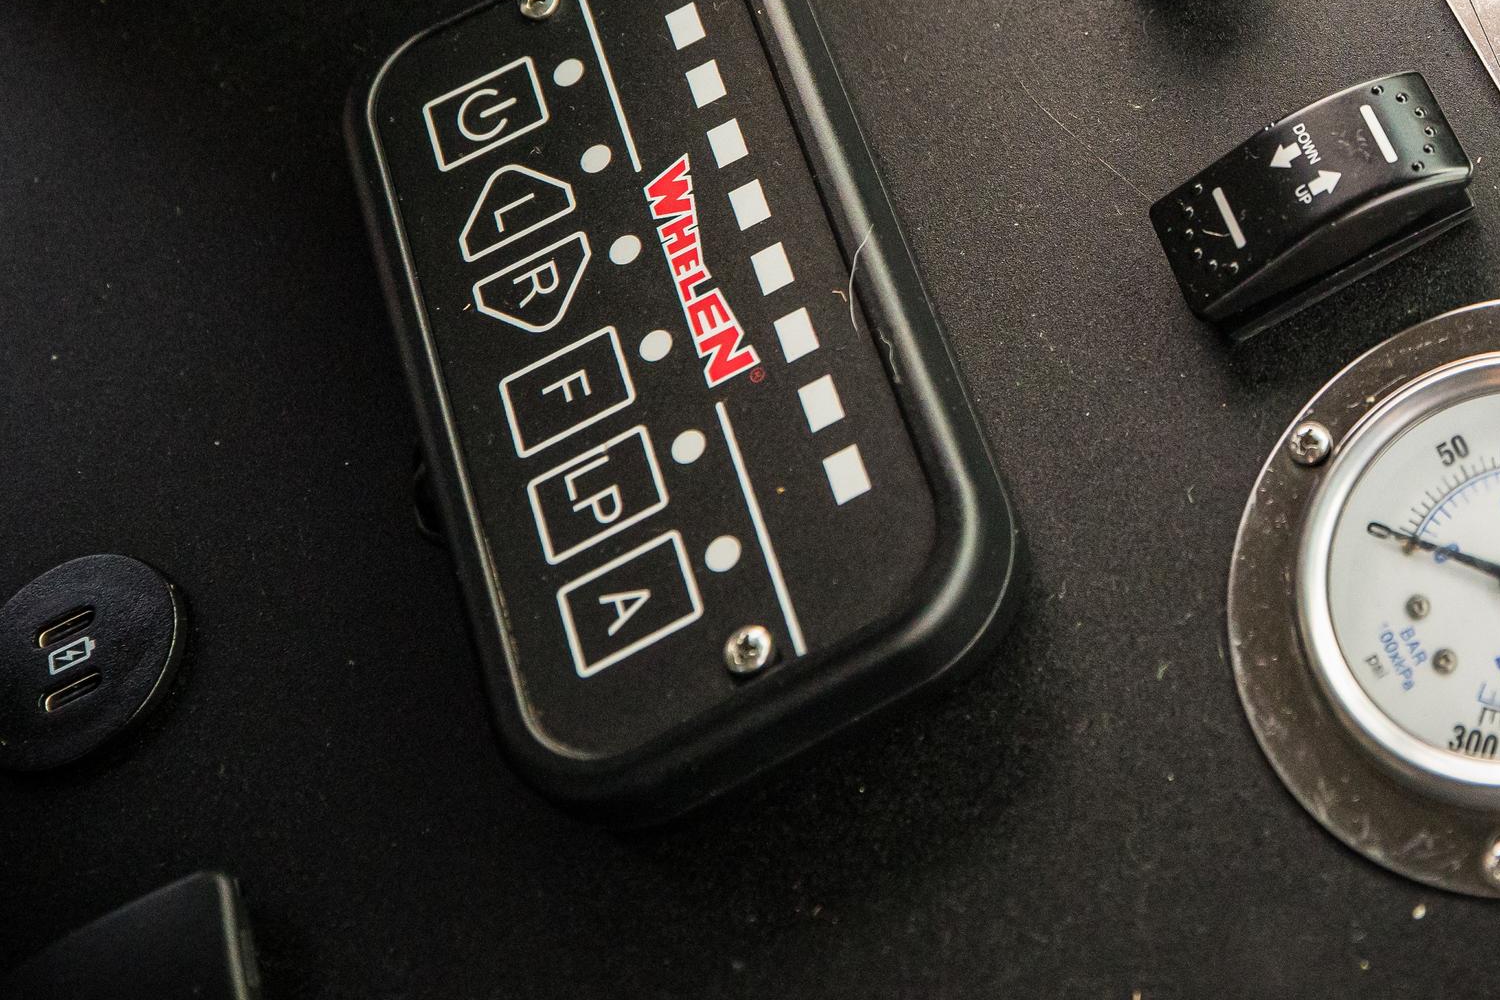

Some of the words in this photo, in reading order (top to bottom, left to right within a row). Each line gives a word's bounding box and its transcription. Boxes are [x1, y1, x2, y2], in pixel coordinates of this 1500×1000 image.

[1292, 123, 1321, 166] DOWN
[494, 193, 535, 233] L
[1294, 184, 1312, 205] UP
[512, 257, 560, 309] R
[643, 152, 761, 389] WHELEN
[542, 369, 592, 403] F
[1435, 434, 1470, 468] 50
[564, 455, 624, 525] LP
[1366, 521, 1391, 539] 0
[599, 588, 651, 637] A
[1380, 621, 1415, 691] 00xkPa
[1400, 626, 1427, 666] BAR
[1448, 724, 1499, 761] 300
